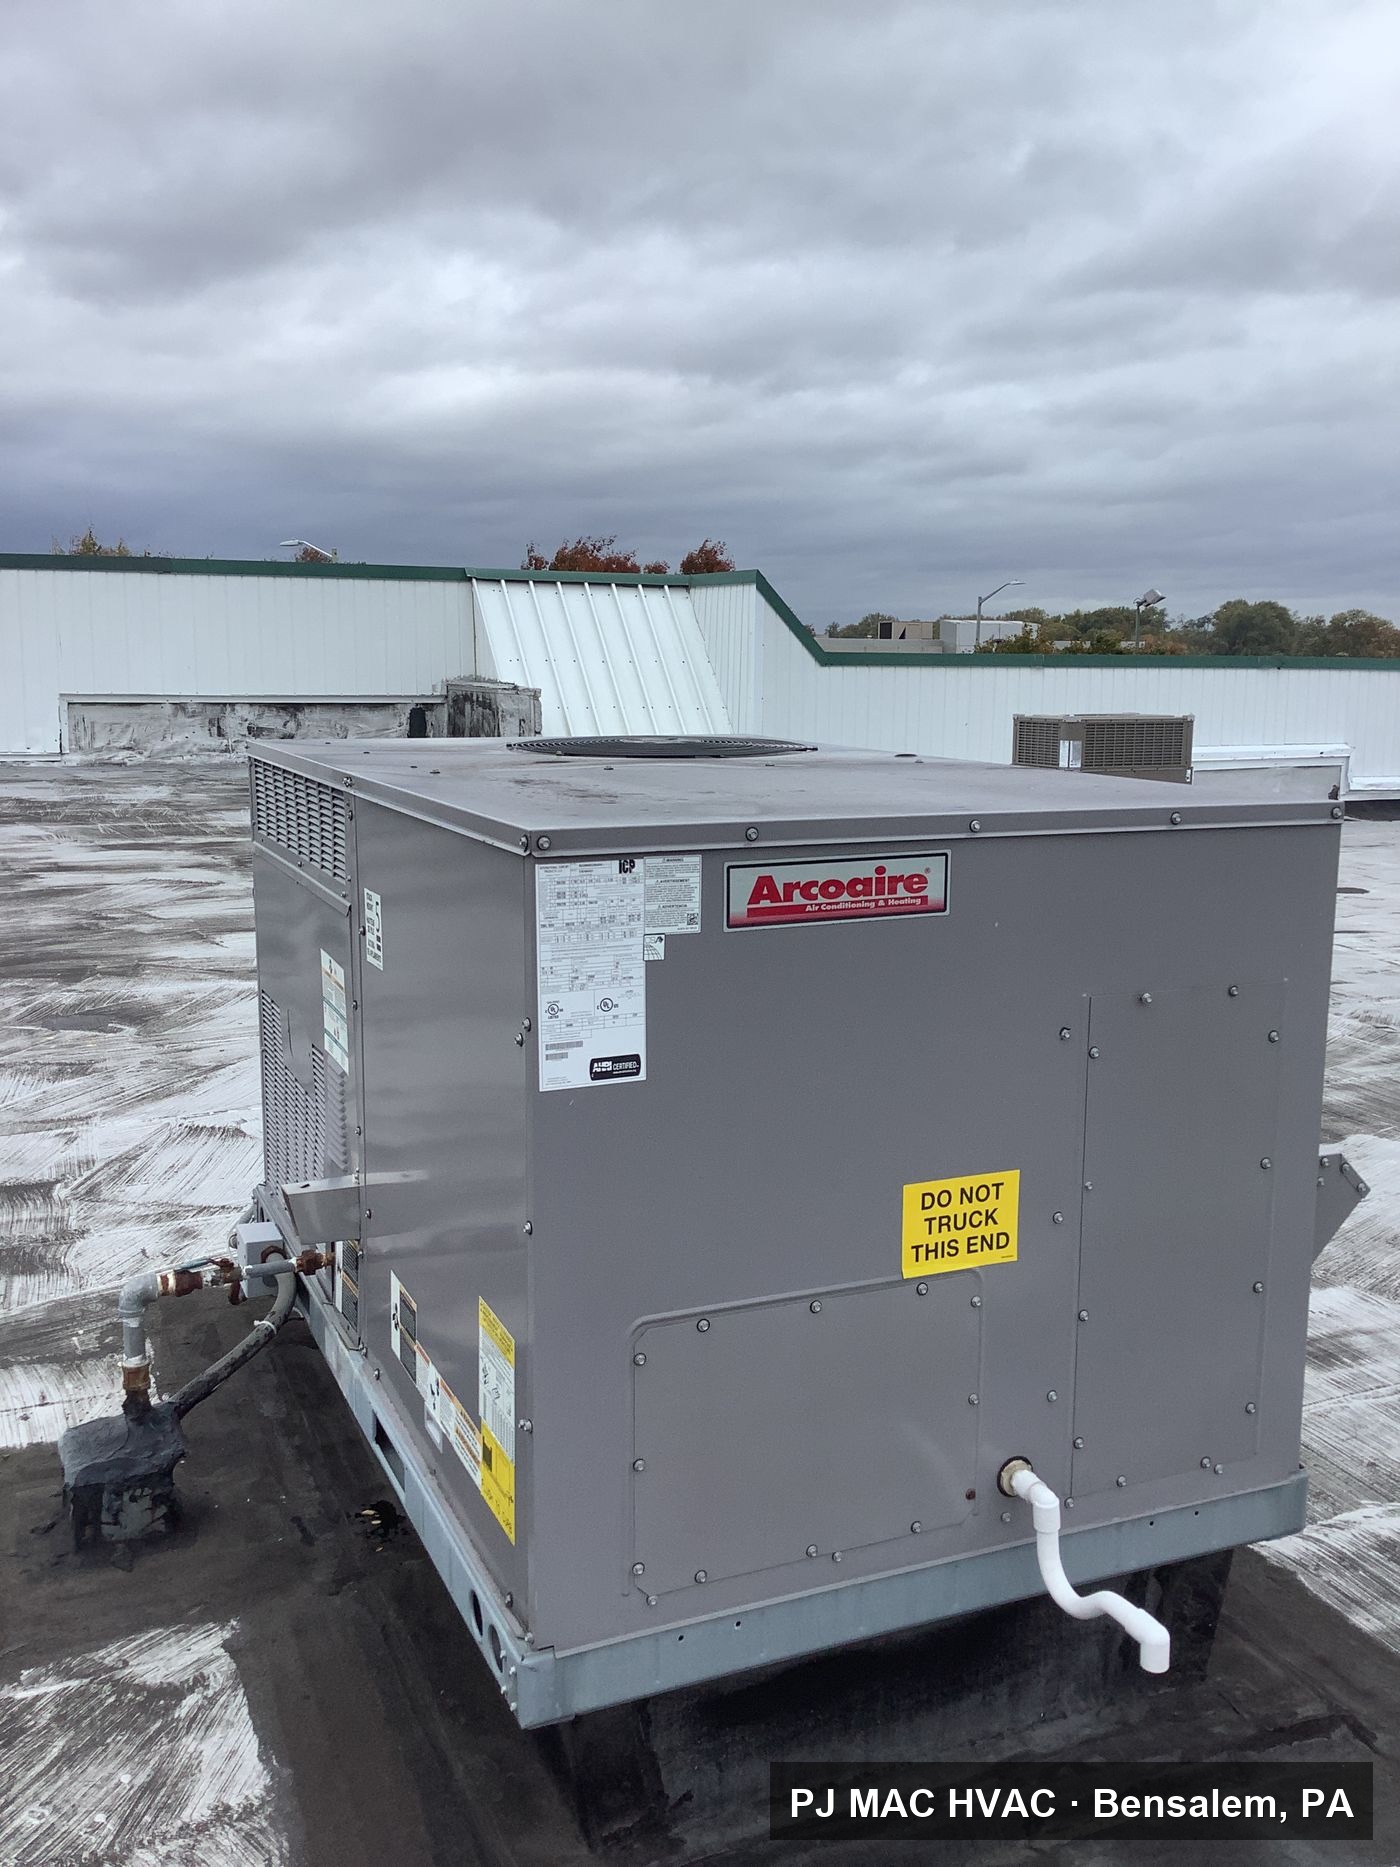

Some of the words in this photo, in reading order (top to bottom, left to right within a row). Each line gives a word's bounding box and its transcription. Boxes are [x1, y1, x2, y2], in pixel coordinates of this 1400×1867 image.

[747, 865, 929, 906] Arcoaire
[805, 904, 820, 912] Air
[821, 899, 876, 911] Conditioning
[888, 896, 921, 906] Heating
[612, 1061, 637, 1071] CERTIFIED
[921, 1189, 952, 1211] DO
[960, 1182, 1004, 1205] NOT
[924, 1208, 998, 1235] TRUCK
[911, 1239, 959, 1262] THIS
[967, 1232, 1010, 1254] END
